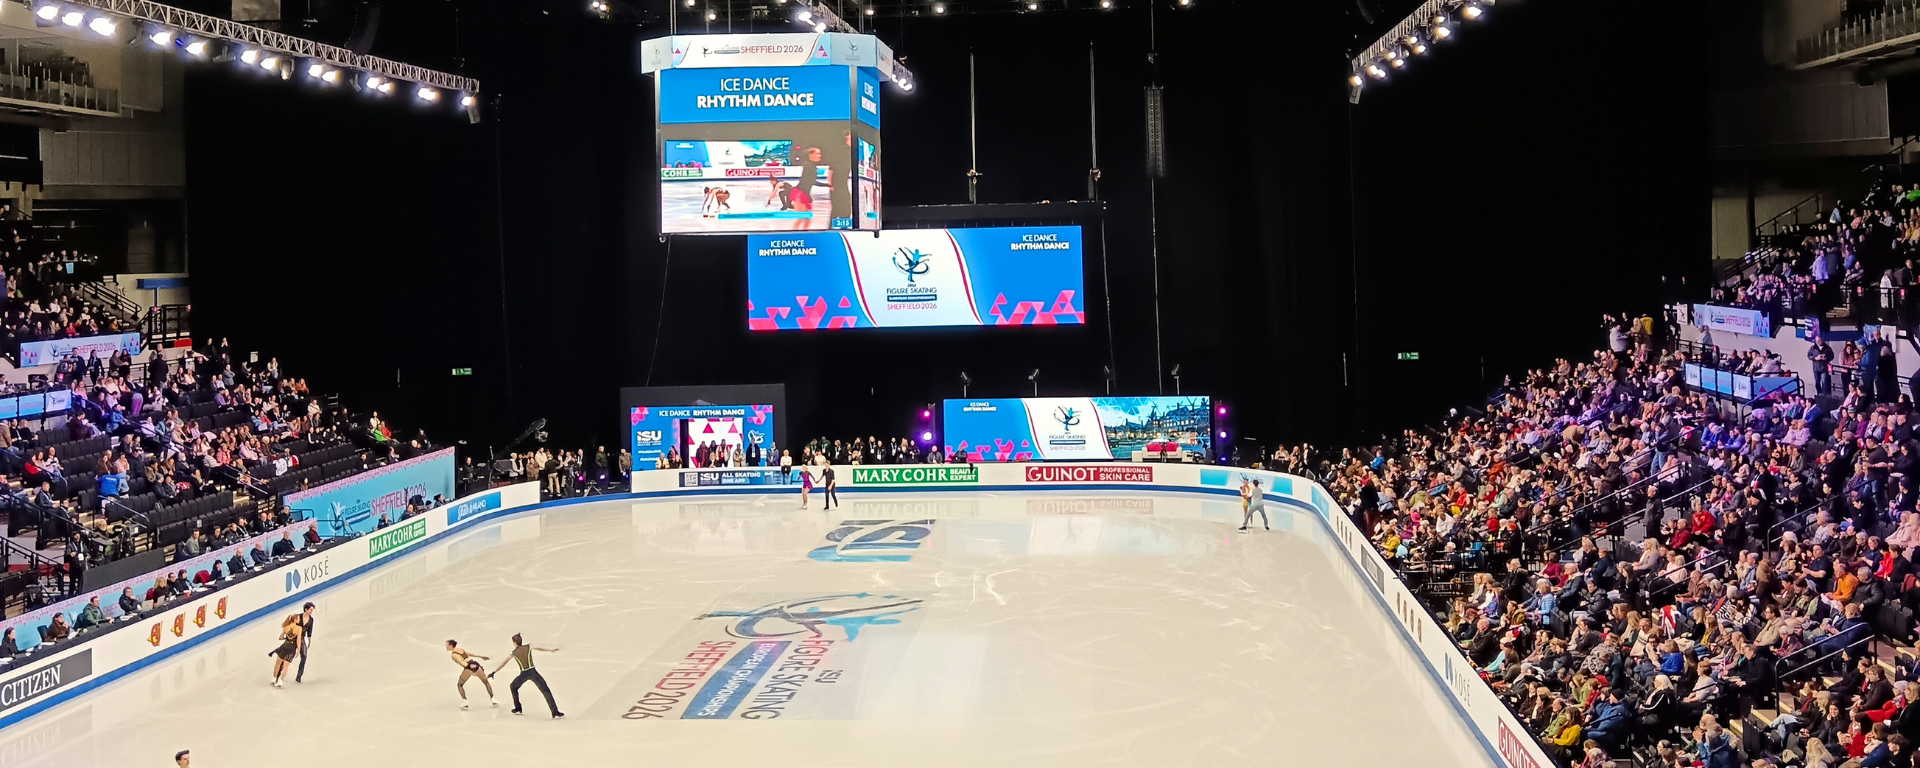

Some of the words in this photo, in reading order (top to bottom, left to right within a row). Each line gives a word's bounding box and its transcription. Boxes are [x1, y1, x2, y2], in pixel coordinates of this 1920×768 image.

[741, 45, 782, 54] SHEFFIELD
[783, 45, 803, 53] 2026
[721, 78, 740, 91] ICE
[743, 77, 789, 91] DANCE
[697, 94, 761, 108] RHYTHM
[764, 93, 814, 107] DANCE
[771, 240, 781, 248] ICE
[1022, 234, 1033, 242] ICE
[636, 430, 662, 441] ISU
[700, 472, 719, 481] ISU
[855, 469, 900, 482] MARY
[902, 469, 948, 481] COHR
[1028, 467, 1097, 481] GUINOT
[370, 532, 392, 556] MARY
[392, 525, 414, 546] COHR
[807, 519, 936, 562] ISU
[304, 556, 329, 583] KOSÉ
[655, 640, 737, 690] SHEFFIELD
[740, 642, 778, 669] EUROPEAN
[778, 640, 834, 671] FIGURE
[1, 664, 61, 706] CITIZEN
[815, 669, 843, 683] ISU
[740, 673, 809, 719] SKATING
[1454, 668, 1471, 707] KOSÉ
[621, 691, 686, 719] 2026
